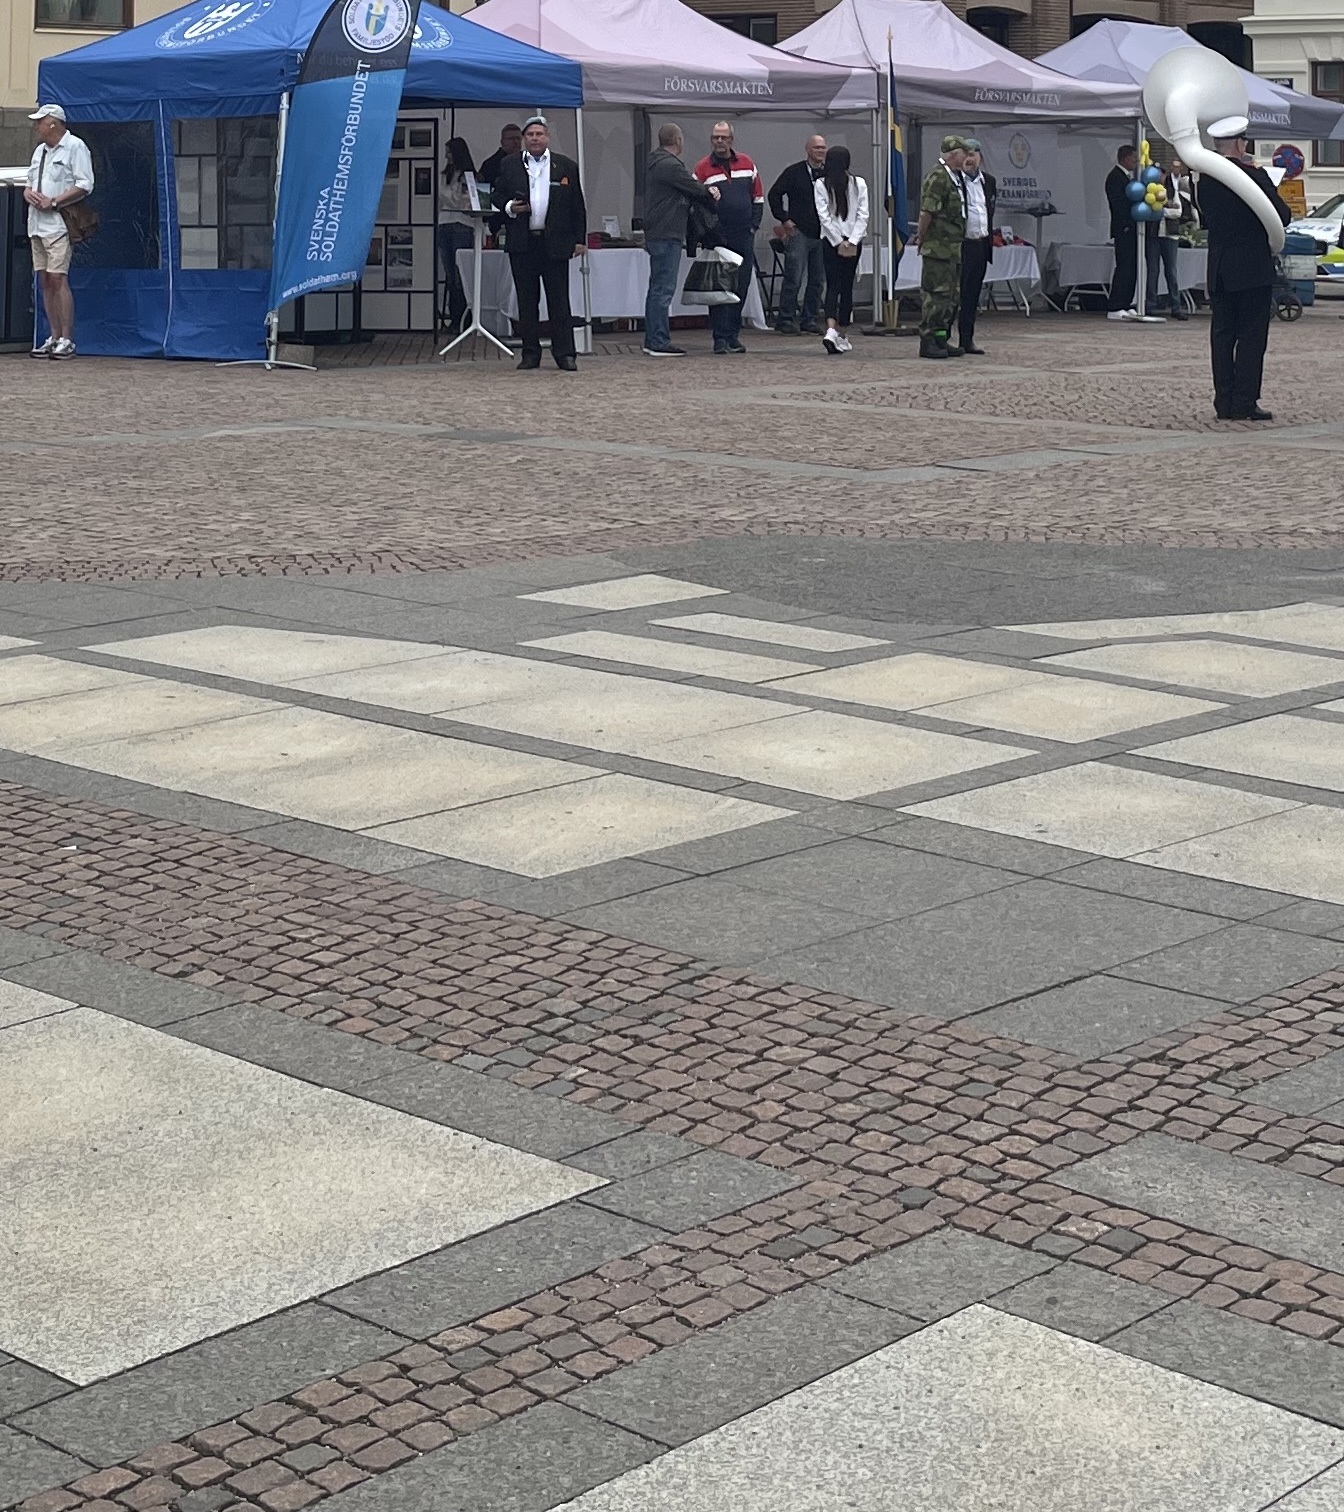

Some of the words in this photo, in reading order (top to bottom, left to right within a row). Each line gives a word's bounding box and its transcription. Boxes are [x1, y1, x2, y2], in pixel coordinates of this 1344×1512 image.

[664, 75, 774, 95] FÖRSVARSMAKTEN
[974, 88, 1061, 107] FÖRSVARSMAKTEN
[1248, 110, 1292, 126] ARSMAKTEN
[320, 59, 371, 262] SOLDATHEMSFÖRBUNDET
[1002, 176, 1037, 187] SVERIGES
[307, 186, 331, 261] SVENSKA
[282, 271, 357, 299] www.soldathem.org
